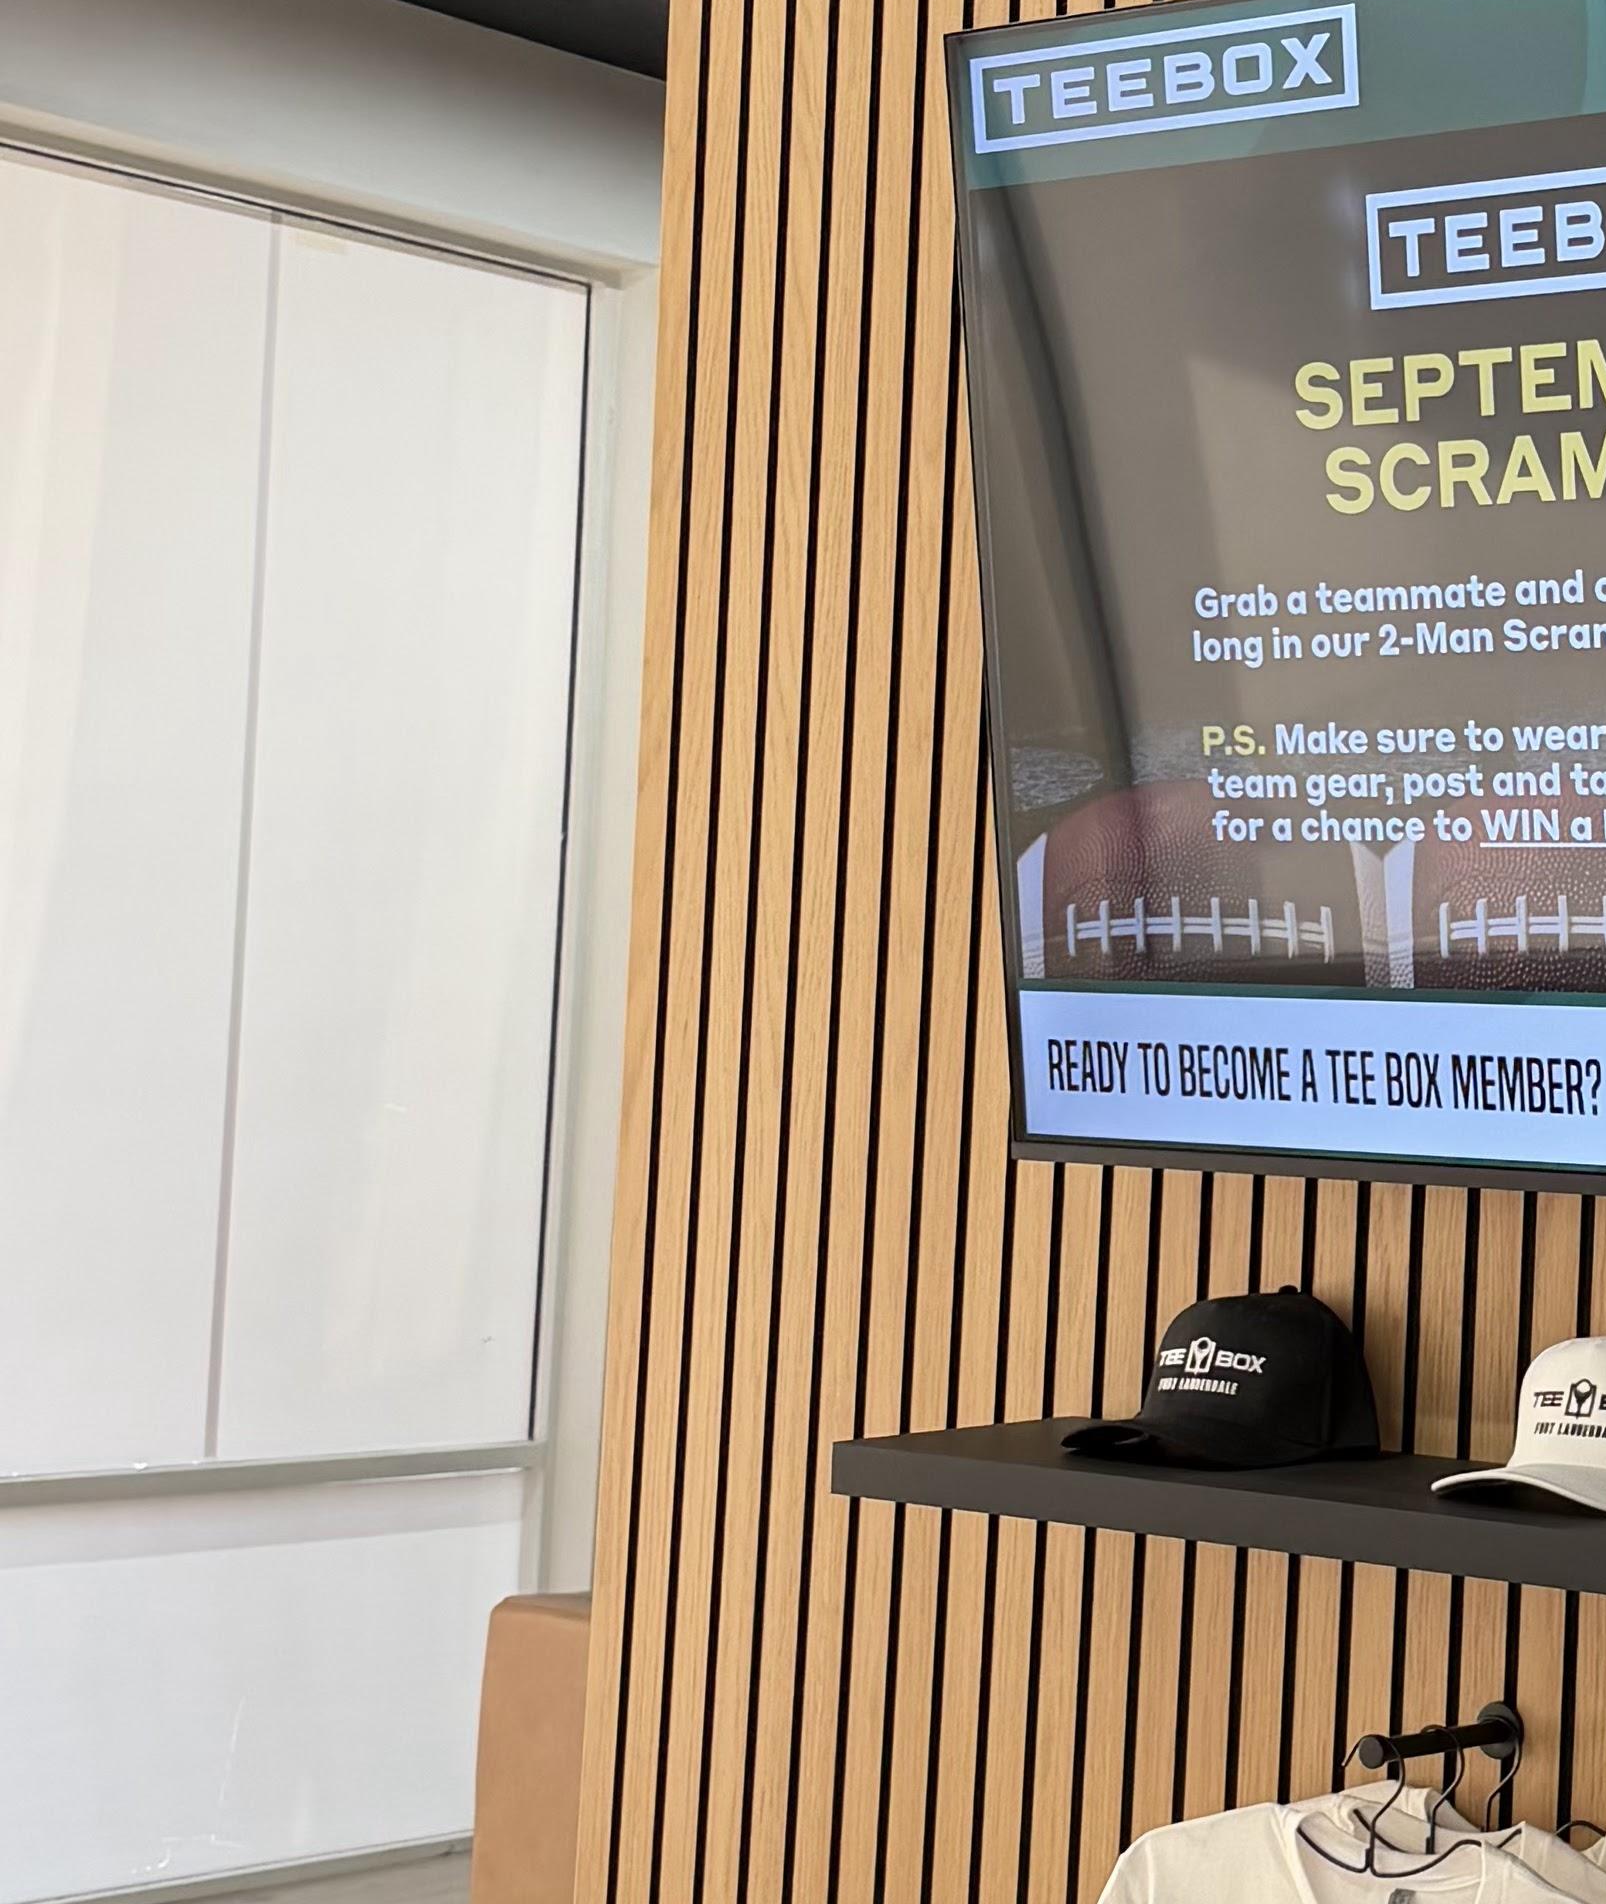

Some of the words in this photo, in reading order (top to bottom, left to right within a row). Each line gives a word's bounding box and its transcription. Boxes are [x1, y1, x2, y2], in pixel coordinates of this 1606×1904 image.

[992, 31, 1333, 126] TEEBOX
[1194, 583, 1278, 619] Grab
[1286, 590, 1307, 615] a
[1314, 574, 1506, 614] teammate
[1515, 568, 1585, 606] and
[1193, 630, 1264, 669] long
[1272, 626, 1303, 659] in
[1311, 632, 1370, 658] our
[1378, 621, 1494, 656] 2-Man
[1202, 724, 1266, 756] P.S.
[1275, 721, 1369, 755] Make
[1376, 728, 1456, 754] sure
[1463, 719, 1504, 752] to
[1512, 724, 1606, 751] wear
[1207, 767, 1297, 799] team
[1305, 773, 1394, 807] gear,
[1403, 764, 1484, 805] post
[1492, 762, 1561, 797] and
[1211, 809, 1264, 842] for
[1271, 818, 1292, 842] a
[1302, 810, 1425, 842] chance
[1432, 809, 1473, 842] to
[1480, 808, 1560, 841] WIN
[1570, 816, 1593, 841] a
[1047, 1038, 1129, 1094] READY
[1137, 1042, 1171, 1097] TO
[1178, 1044, 1292, 1102] BECOME
[1301, 1048, 1318, 1103] A
[1325, 1049, 1377, 1106] TEE
[1385, 1051, 1443, 1109] BOX
[1451, 1054, 1602, 1116] MEMBER?
[1159, 1348, 1187, 1367] TEE
[1215, 1349, 1267, 1374] BOX
[1533, 1391, 1565, 1408] TEE
